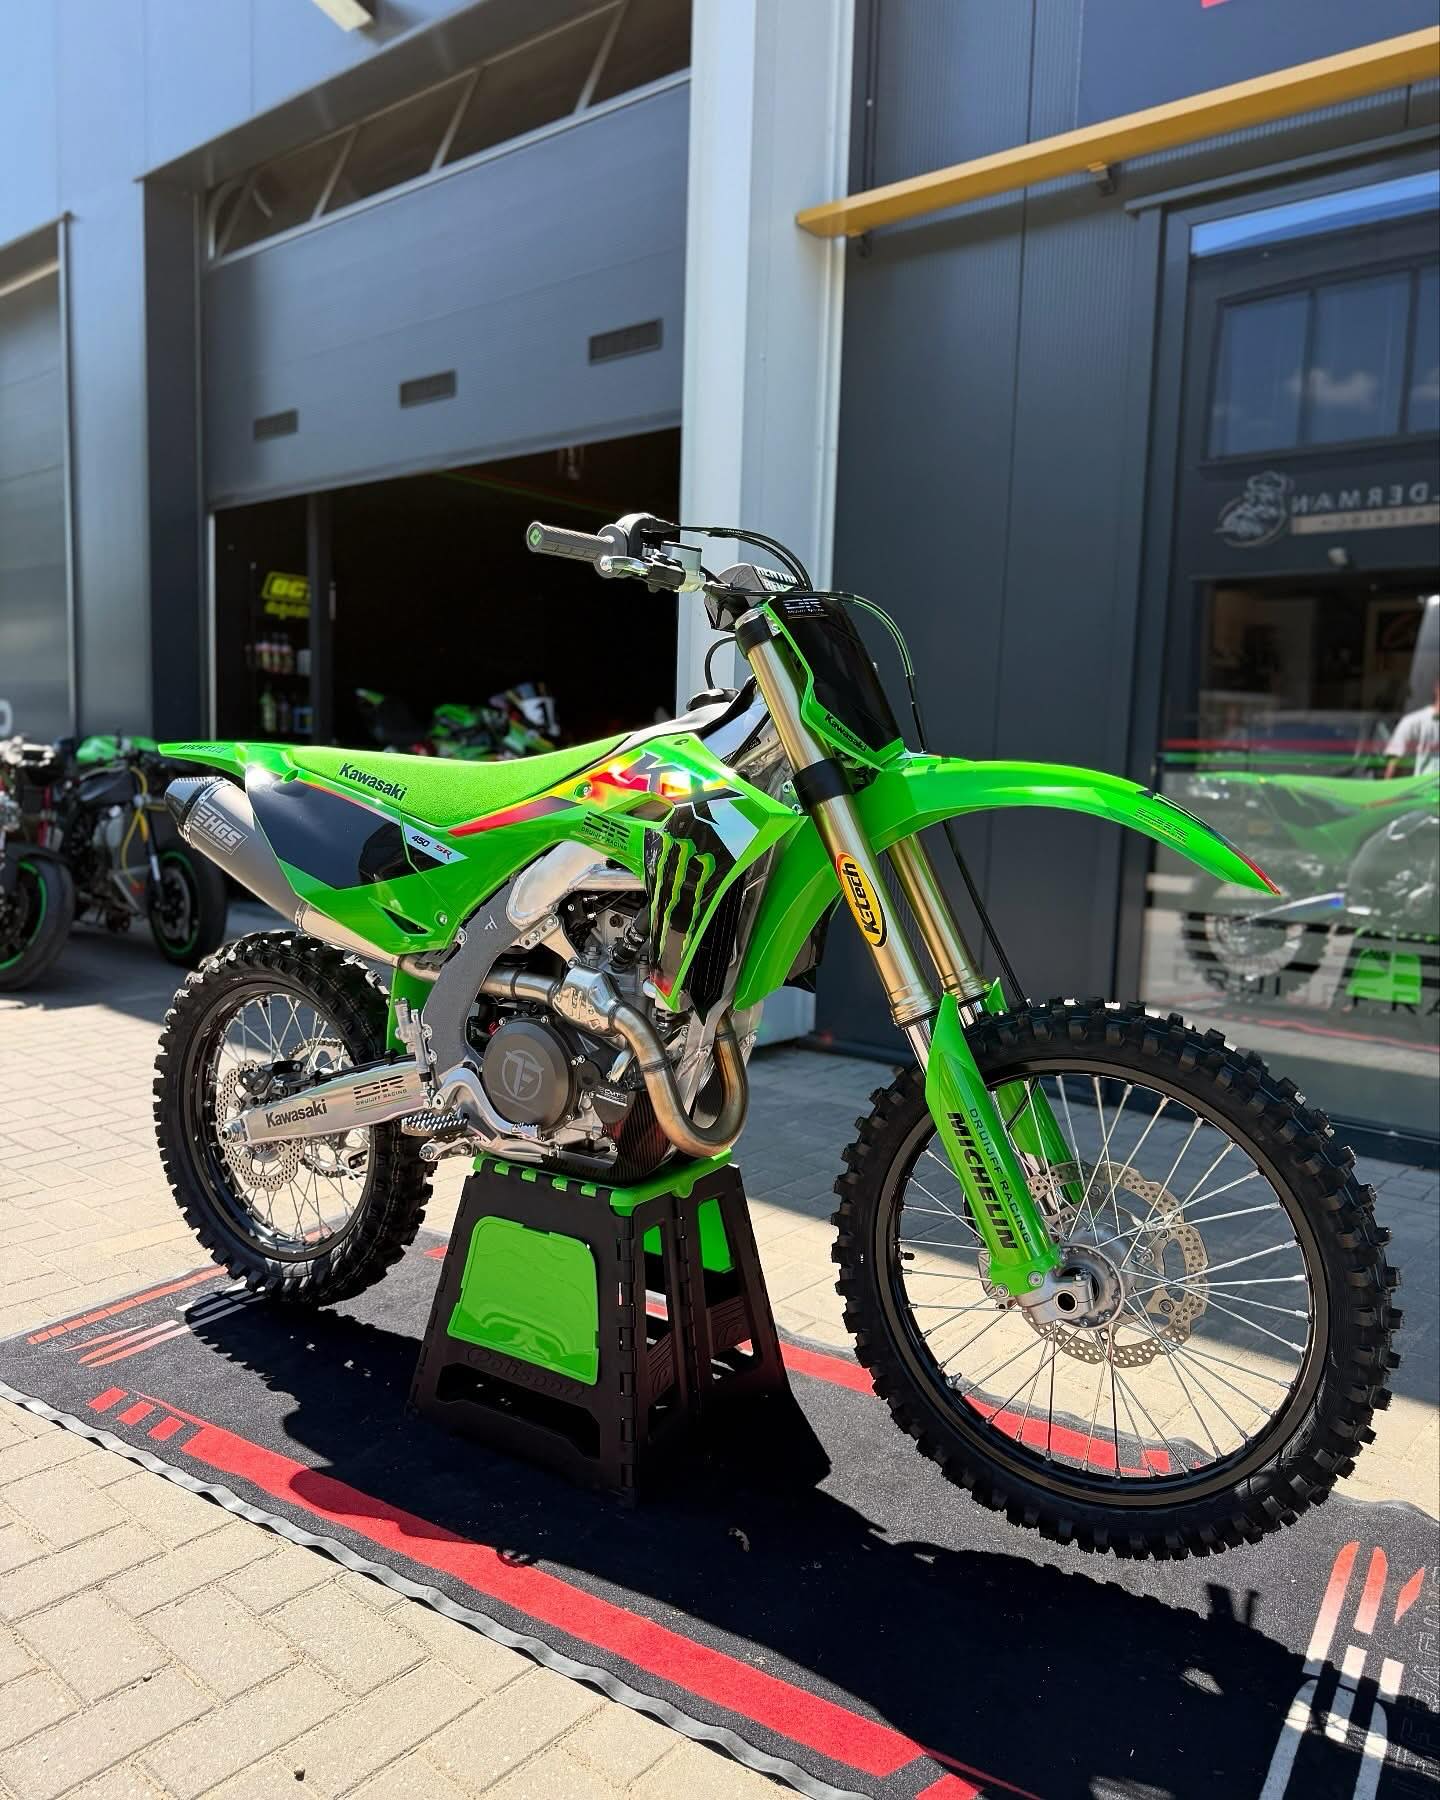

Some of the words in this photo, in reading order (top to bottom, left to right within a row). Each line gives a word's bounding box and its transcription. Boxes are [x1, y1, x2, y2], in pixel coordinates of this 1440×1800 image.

[825, 713, 868, 752] Kawasaki
[339, 762, 407, 801] Kawasaki
[203, 814, 243, 847] HGS
[411, 834, 431, 848] 450
[434, 844, 453, 860] SR
[382, 1088, 408, 1099] RACING
[265, 1099, 328, 1128] Kawasaki
[946, 1112, 1019, 1249] MICHELIN
[969, 1108, 1004, 1175] DRUIJFF
[1000, 1178, 1032, 1243] RACING
